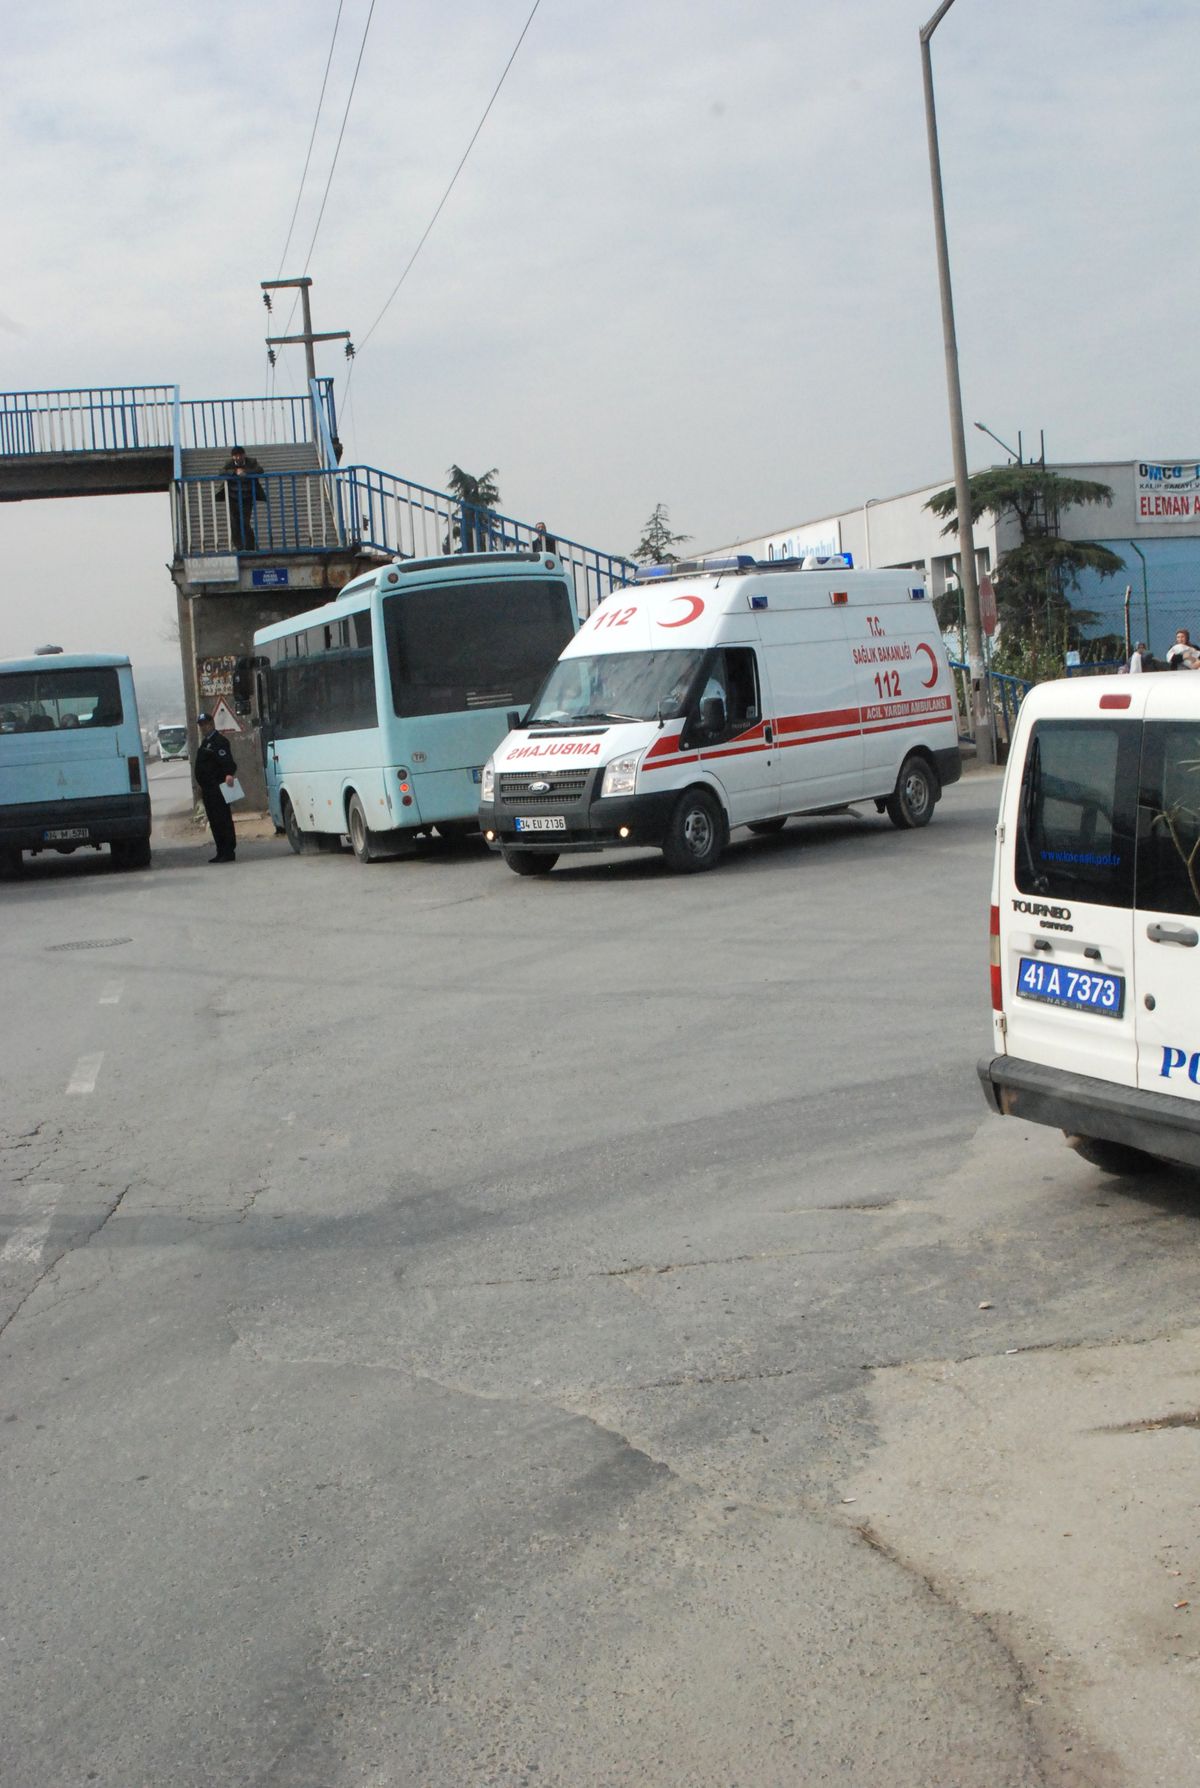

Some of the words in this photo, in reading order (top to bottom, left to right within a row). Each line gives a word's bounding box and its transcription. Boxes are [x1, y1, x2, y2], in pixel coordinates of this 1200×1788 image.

[1139, 463, 1182, 480] OMCO
[1139, 495, 1190, 516] ELEMAN
[593, 606, 638, 631] 112
[852, 644, 879, 665] SAĞLIK
[878, 641, 912, 663] BAKANLIĞI
[874, 670, 902, 699] 112
[884, 703, 910, 717] YARDIM
[520, 820, 530, 830] 34
[533, 819, 543, 829] EU
[545, 819, 565, 829] 2136
[1012, 900, 1072, 921] TOURNEO
[1023, 963, 1044, 991] 41
[1047, 967, 1060, 995] A
[1066, 971, 1116, 1007] 7373
